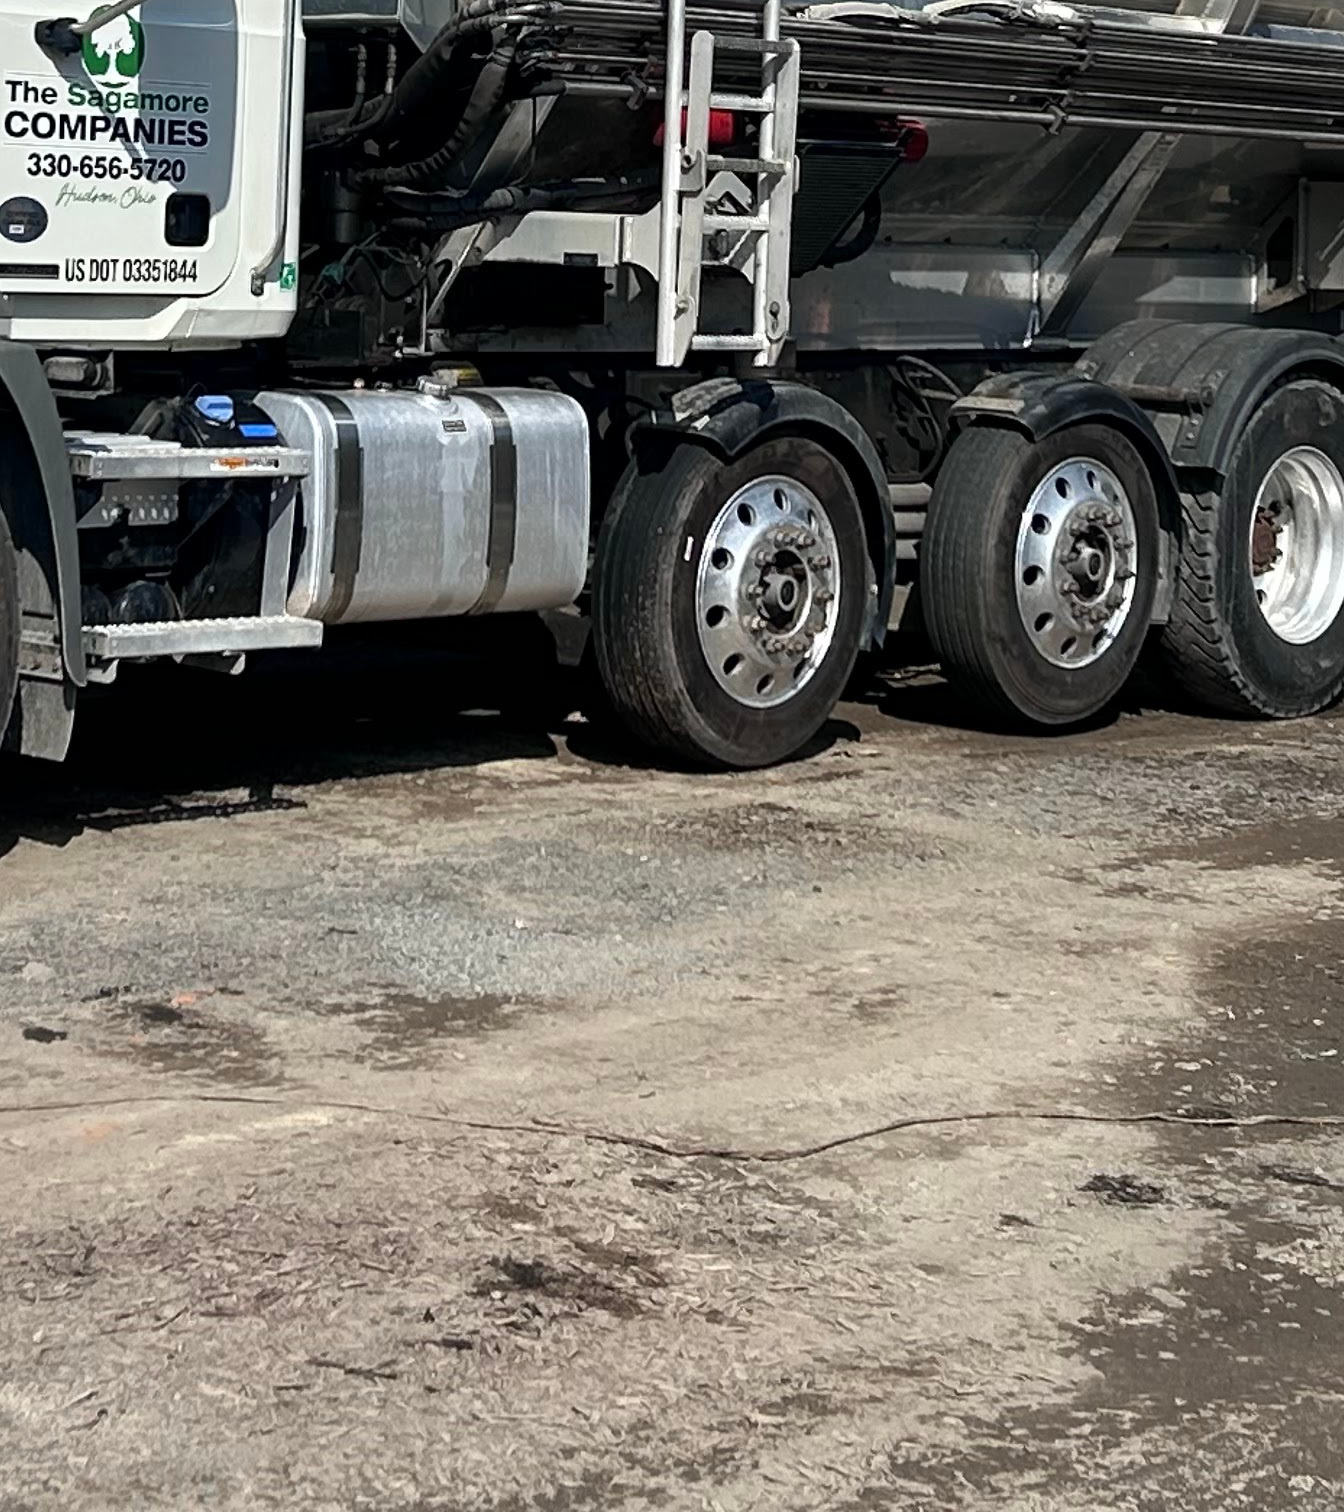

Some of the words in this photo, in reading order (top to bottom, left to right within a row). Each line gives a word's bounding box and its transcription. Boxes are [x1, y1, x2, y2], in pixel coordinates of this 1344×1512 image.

[5, 80, 57, 104] The
[67, 83, 209, 114] Sagamore
[4, 111, 208, 147] COMPANIES
[27, 153, 186, 182] 330-656-5720
[120, 186, 157, 209] Ohio
[65, 259, 85, 282] US
[90, 259, 119, 282] DOT
[123, 259, 198, 282] 03351844
